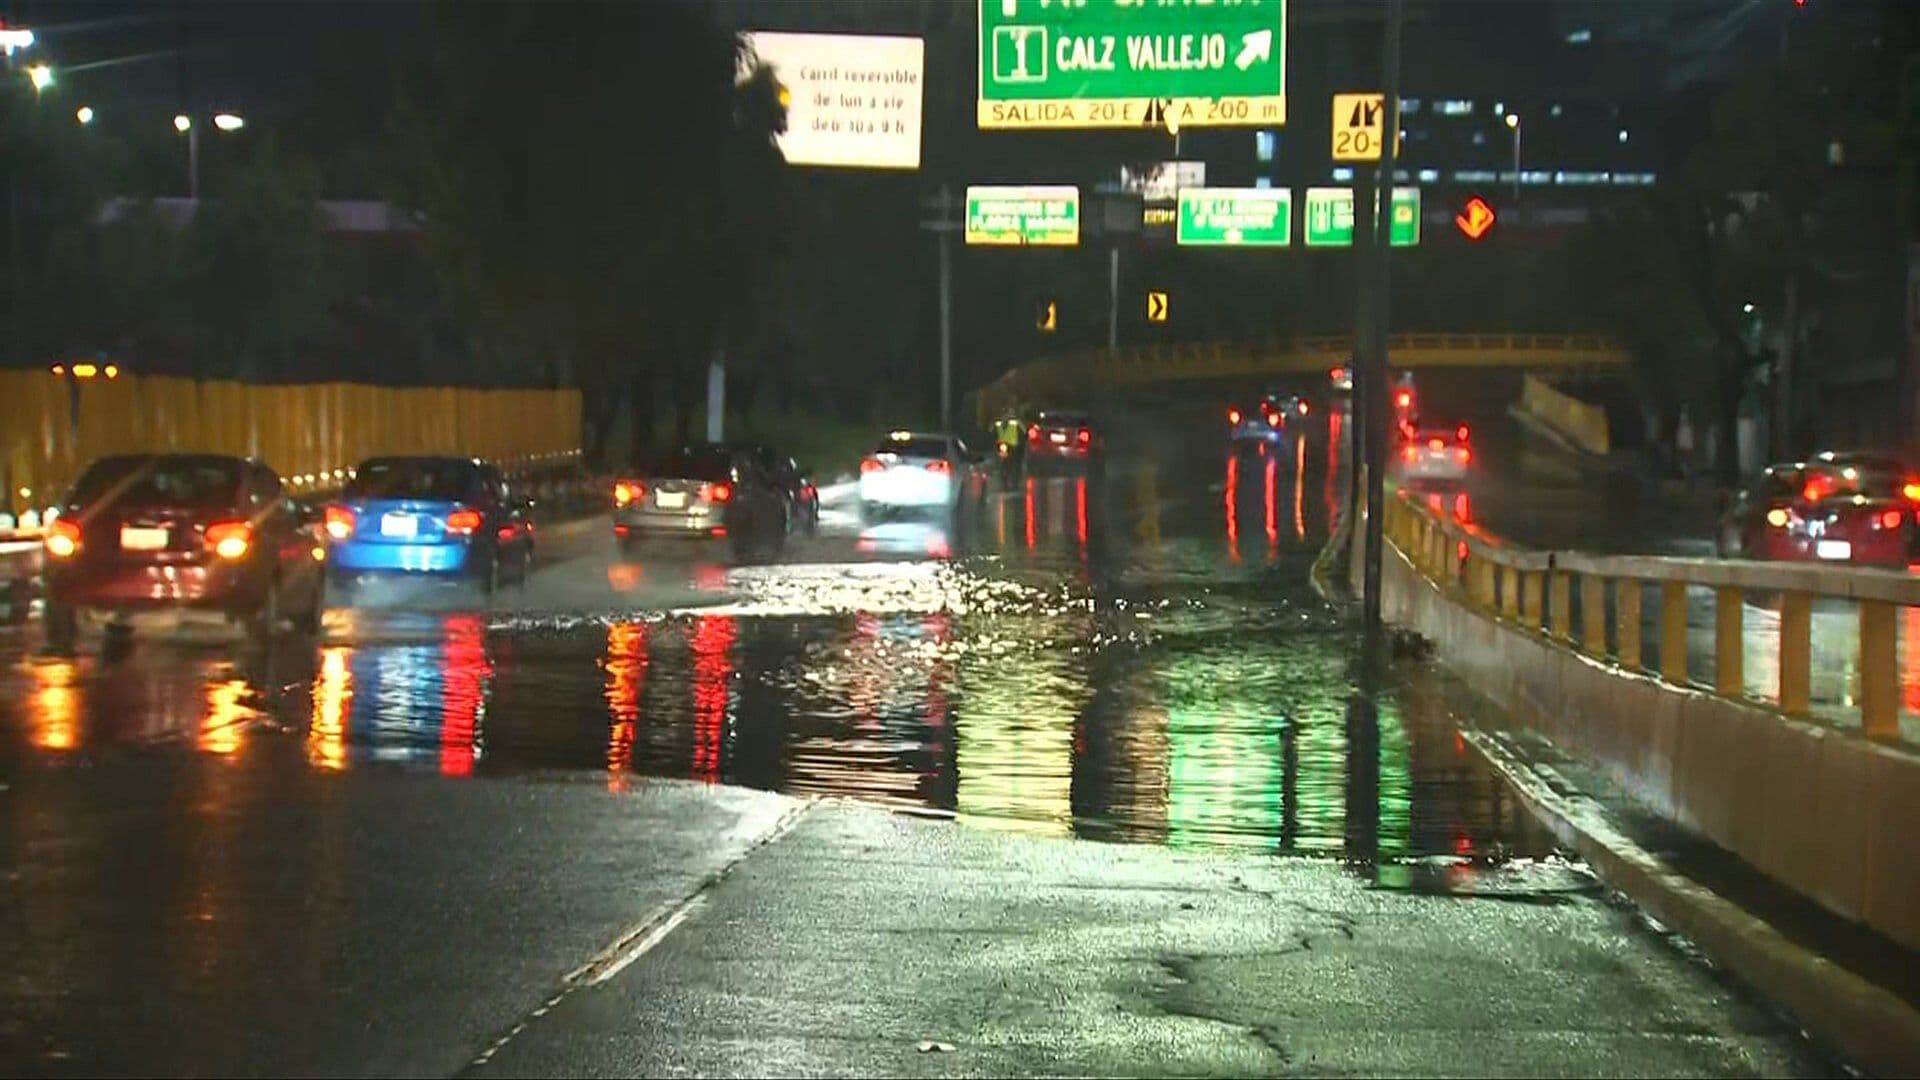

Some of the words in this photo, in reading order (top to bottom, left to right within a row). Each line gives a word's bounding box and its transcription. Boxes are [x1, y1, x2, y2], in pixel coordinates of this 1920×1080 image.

[1056, 35, 1116, 72] CALZ
[1126, 33, 1226, 71] VALLEJO
[992, 103, 1075, 121] SALIDA
[1181, 102, 1194, 119] A
[1206, 101, 1249, 120] 200
